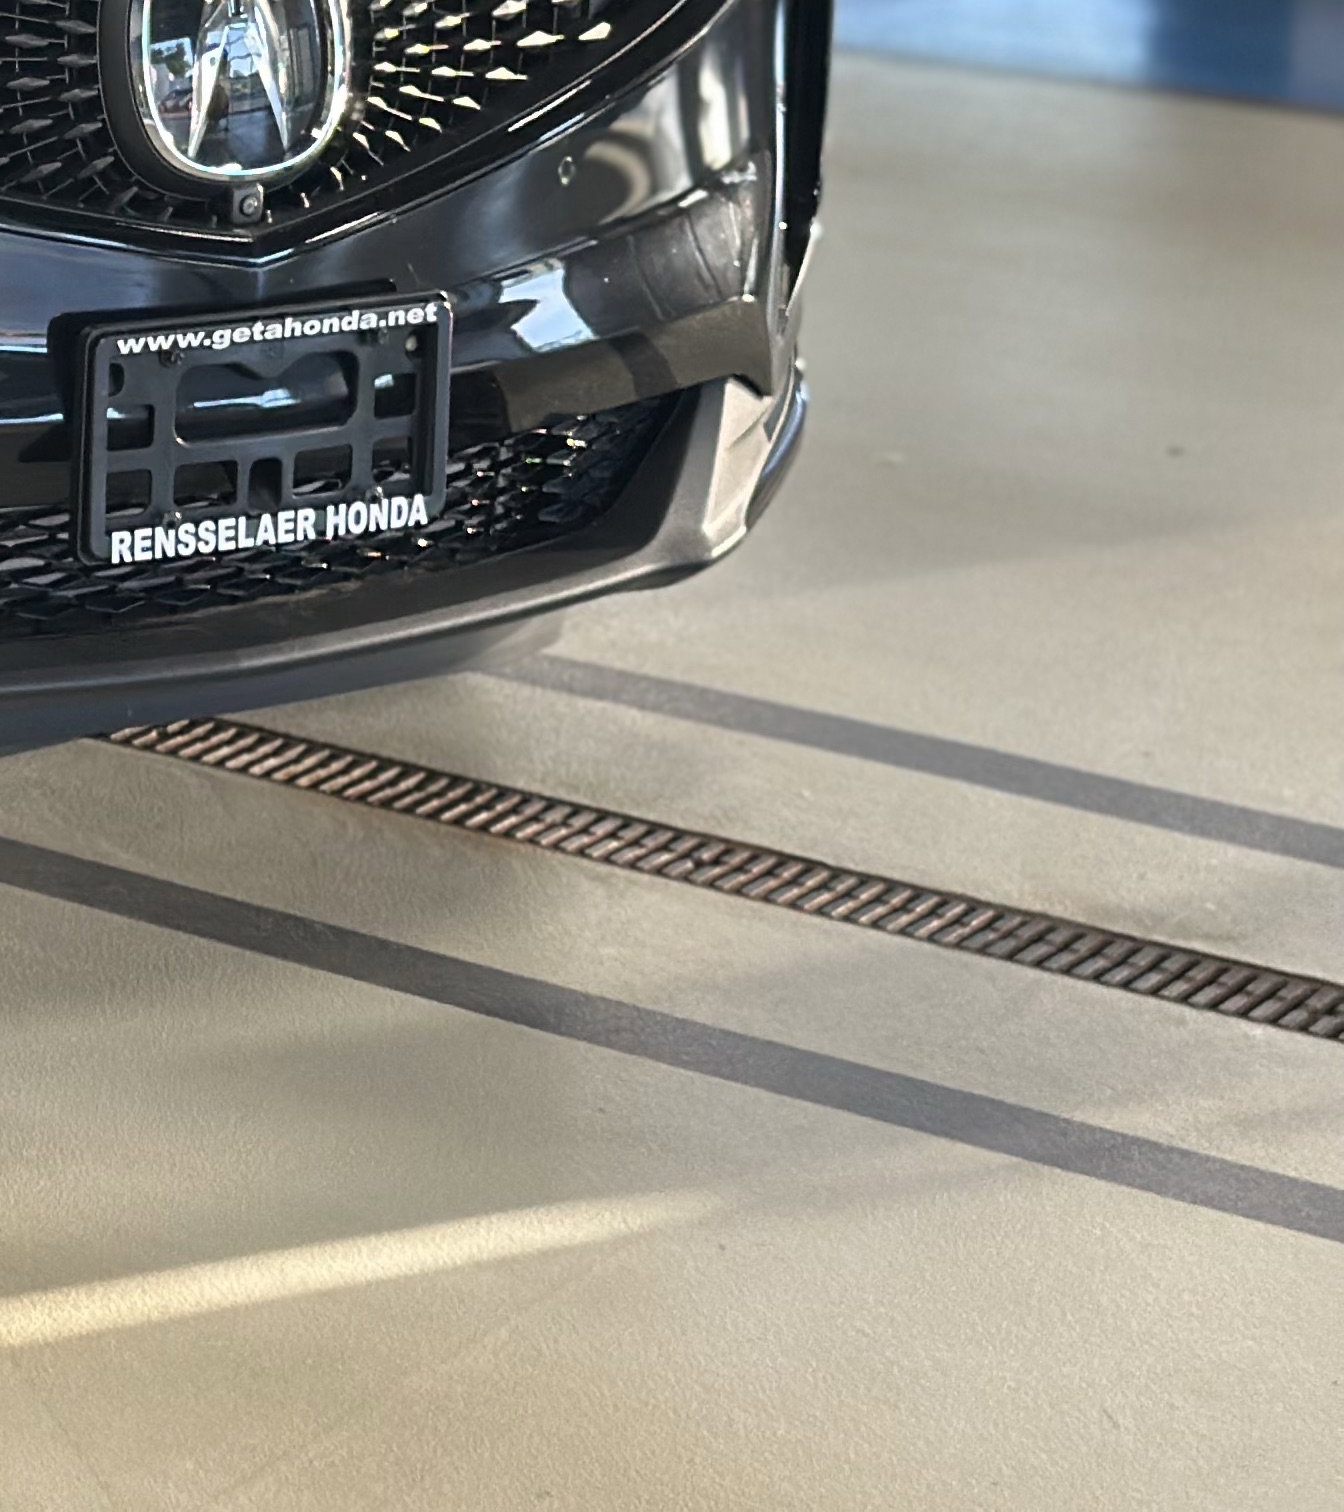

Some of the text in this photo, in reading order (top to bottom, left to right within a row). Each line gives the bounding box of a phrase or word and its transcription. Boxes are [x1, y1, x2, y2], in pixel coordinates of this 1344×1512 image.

[116, 301, 438, 355] www.getahonda.net
[111, 493, 428, 564] RENSSELAER HONDA
